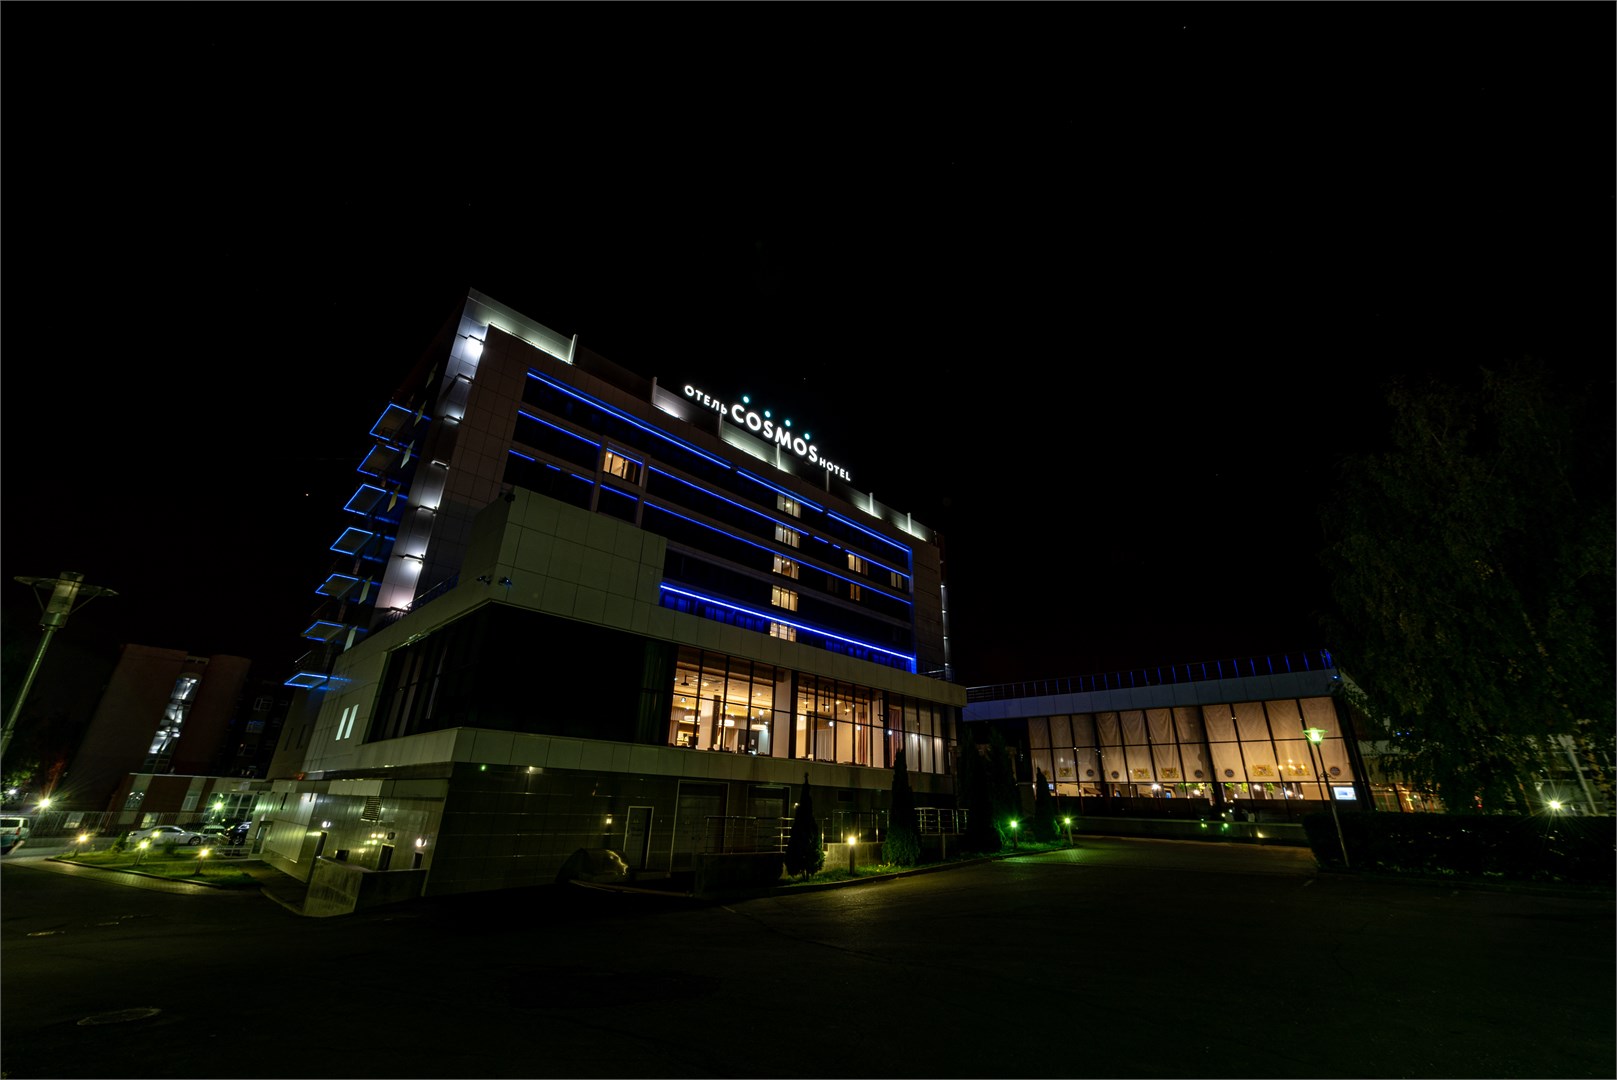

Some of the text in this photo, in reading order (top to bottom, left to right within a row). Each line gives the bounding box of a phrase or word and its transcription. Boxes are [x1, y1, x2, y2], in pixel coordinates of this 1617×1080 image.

[684, 384, 728, 415] ОТЕЛЬ
[731, 404, 851, 482] COSMOS HOTEL
